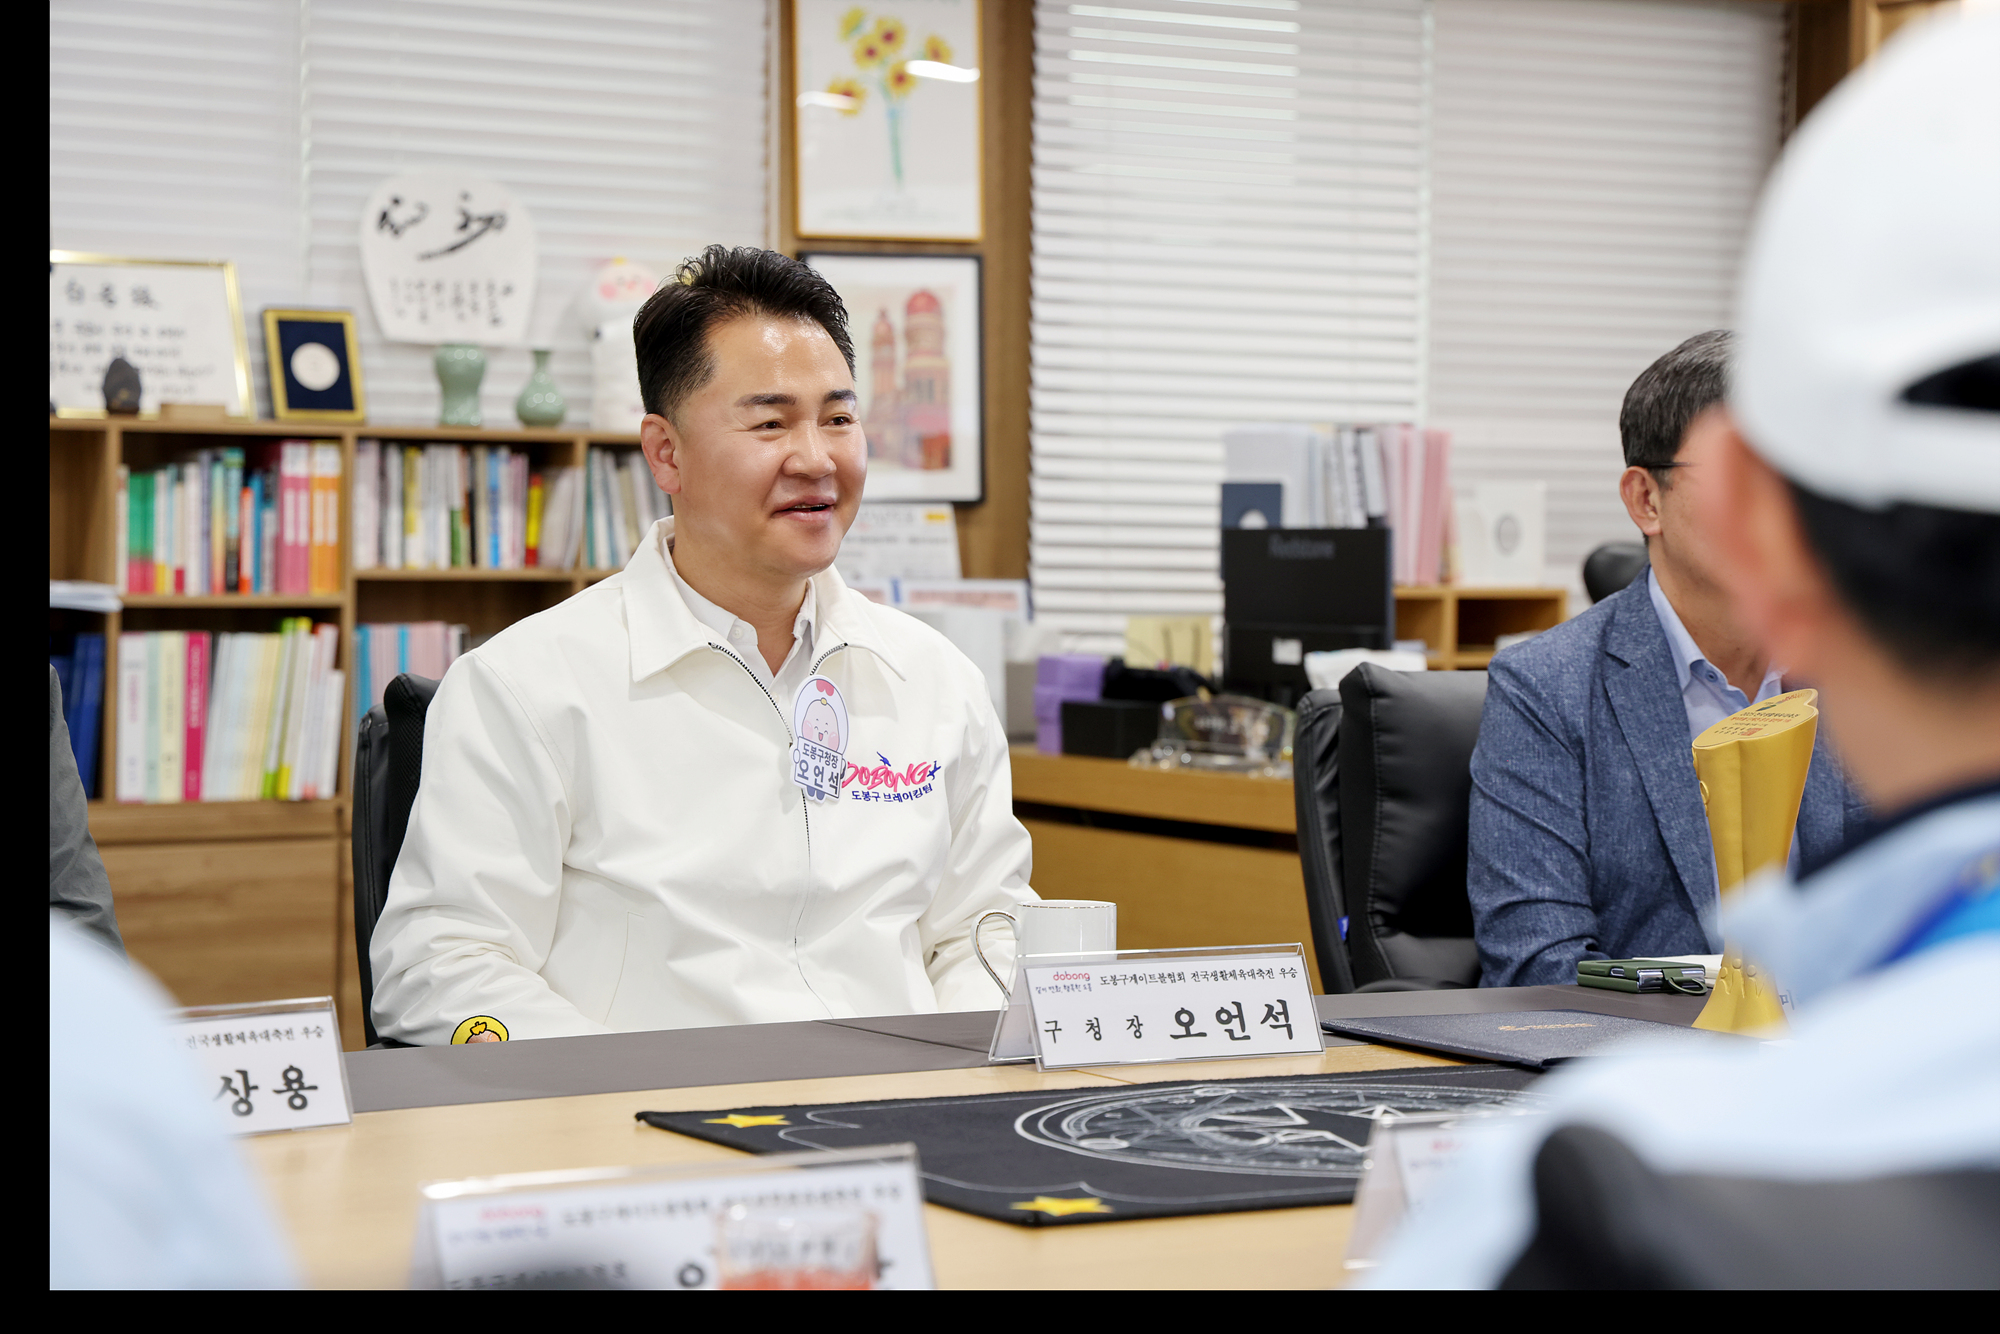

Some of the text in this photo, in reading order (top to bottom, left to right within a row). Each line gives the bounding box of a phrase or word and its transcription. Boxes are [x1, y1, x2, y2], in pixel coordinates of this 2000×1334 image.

[802, 743, 839, 769] 도봉구청장
[851, 782, 933, 802] 도봉구 브레이킹팀
[1053, 971, 1091, 981] dobong
[1100, 966, 1298, 986] 도봉구게이트볼협회 전국생활체육대축전 우승
[301, 1025, 325, 1038] 우승
